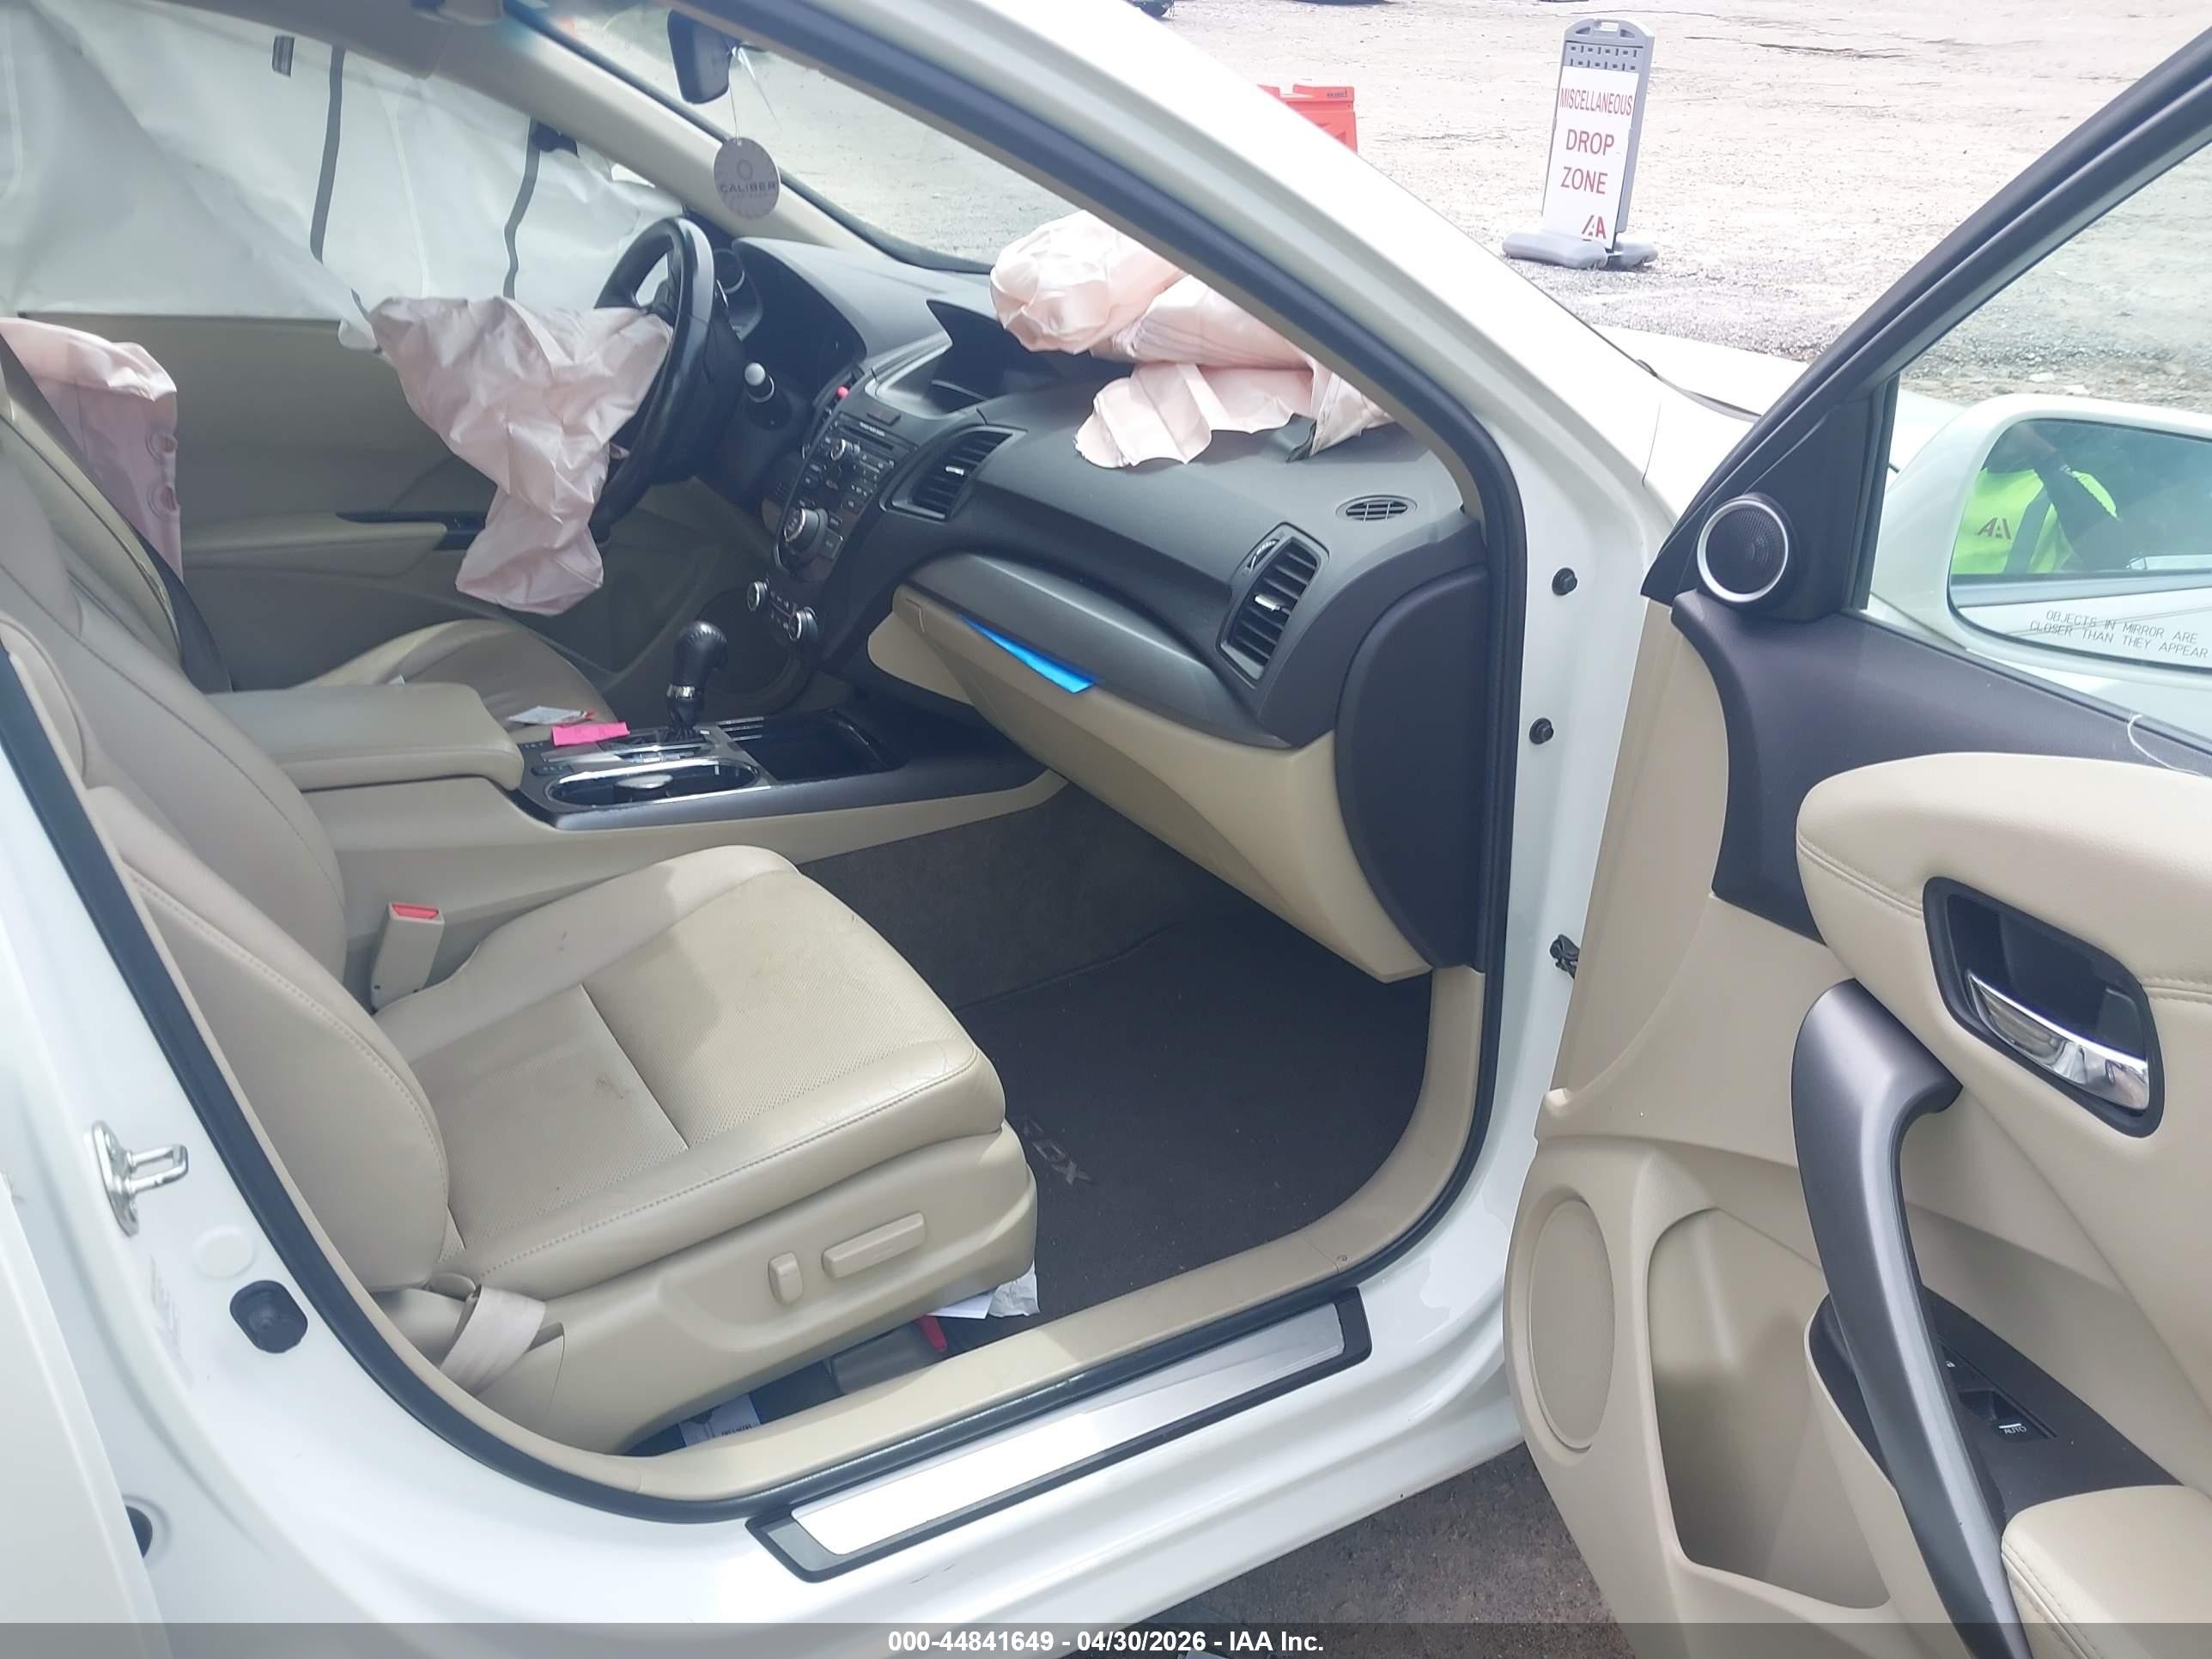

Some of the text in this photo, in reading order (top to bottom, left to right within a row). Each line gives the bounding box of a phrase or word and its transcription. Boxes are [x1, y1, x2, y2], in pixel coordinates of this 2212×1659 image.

[1559, 88, 1632, 117] MISCELLANEOUS
[1565, 130, 1614, 156] DROP
[1560, 167, 1608, 195] ZONE
[2030, 620, 2209, 659] CLOSER THAN THEY APPEAR
[2046, 610, 2198, 644] OBJECTS IN MIRROR ARE
